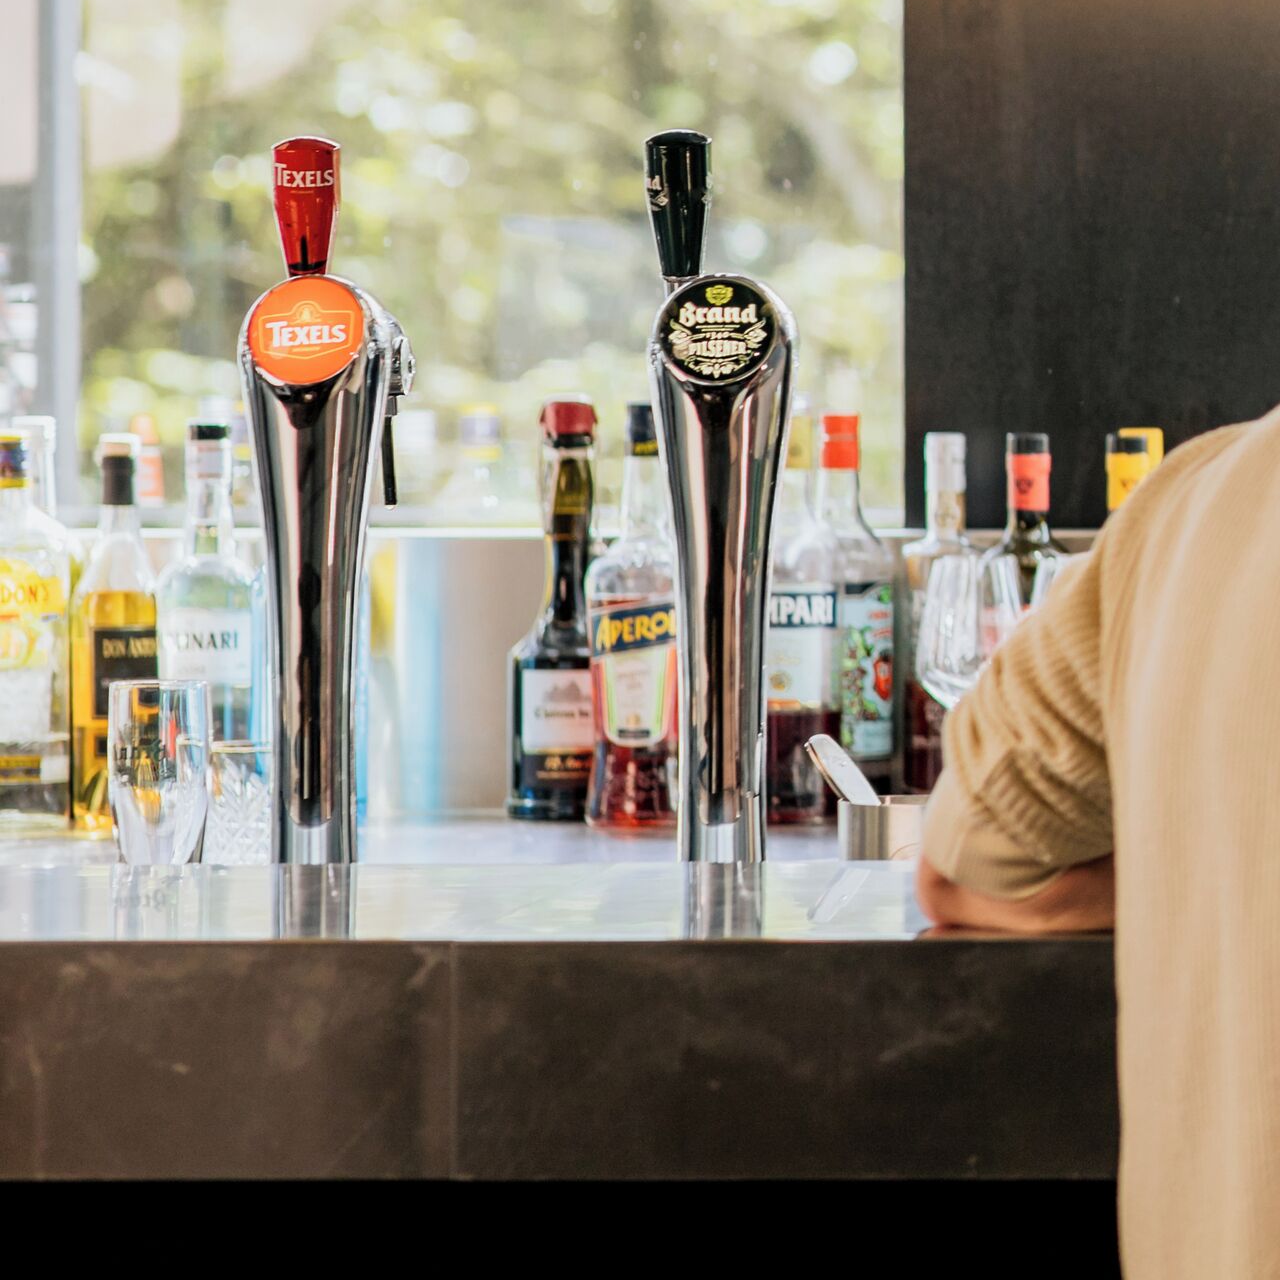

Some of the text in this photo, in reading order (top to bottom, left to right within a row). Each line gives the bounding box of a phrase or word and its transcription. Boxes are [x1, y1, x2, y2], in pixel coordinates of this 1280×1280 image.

[273, 163, 334, 188] TEXELS
[678, 301, 758, 328] Brand
[265, 321, 347, 348] TEXELS
[687, 340, 747, 357] PILSENER
